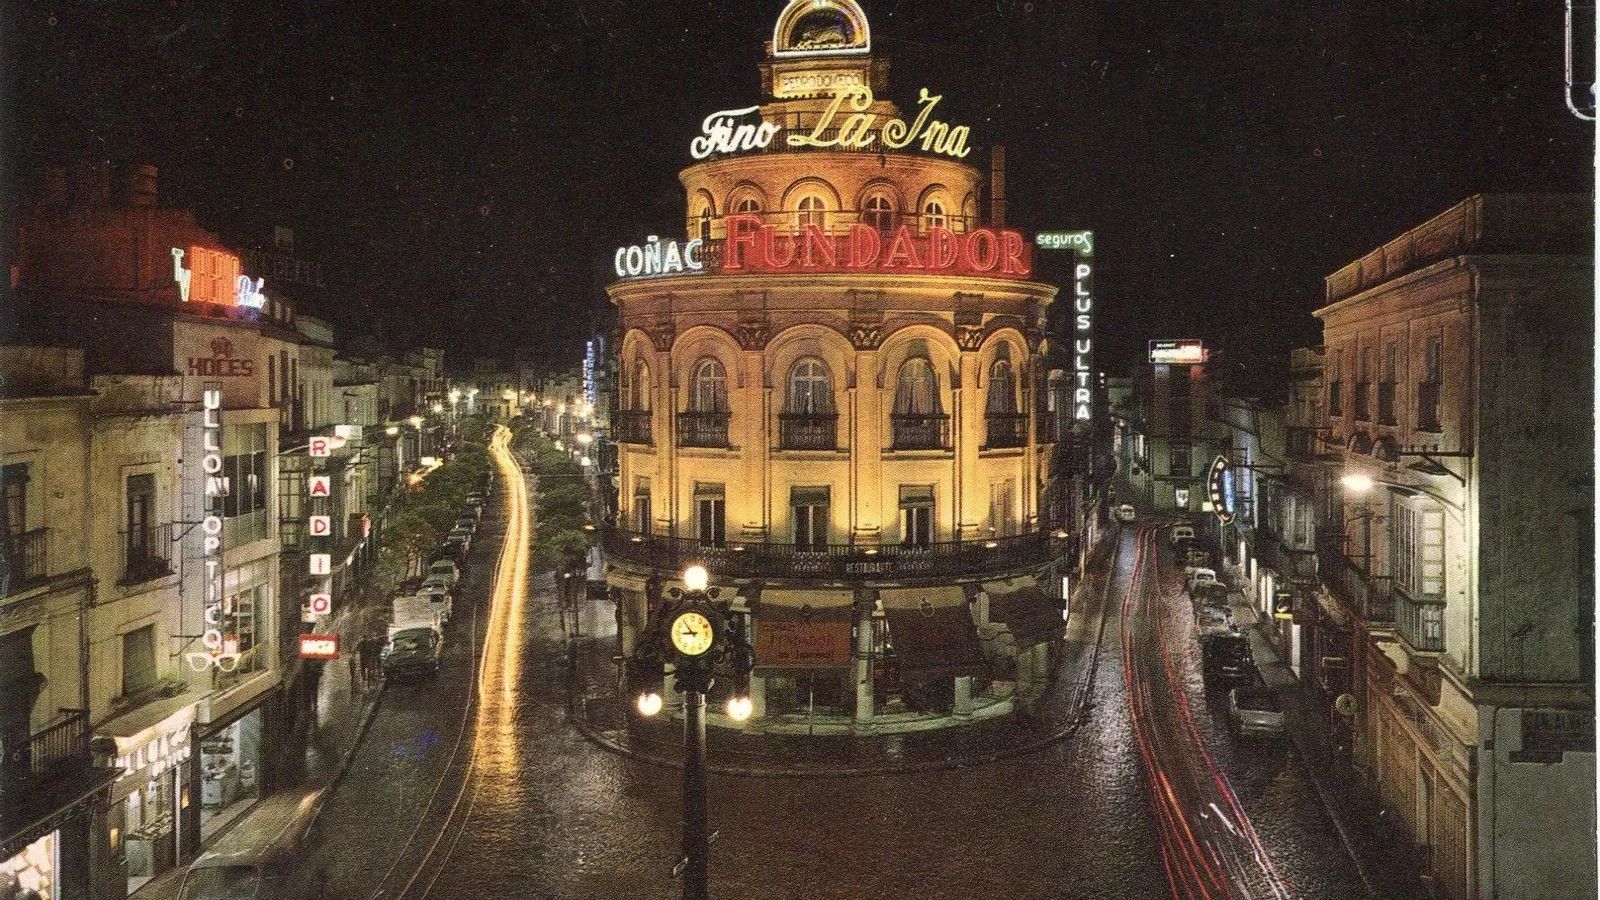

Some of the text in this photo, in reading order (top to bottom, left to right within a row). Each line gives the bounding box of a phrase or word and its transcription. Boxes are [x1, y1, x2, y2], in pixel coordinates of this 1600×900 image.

[690, 105, 781, 159] Fino
[788, 86, 876, 147] La
[615, 213, 1031, 276] COÑAC FUNDADOR
[1076, 263, 1091, 420] PLUS ULTRA
[203, 390, 222, 649] ULLOA OPTICO
[312, 438, 329, 613] RADIO
